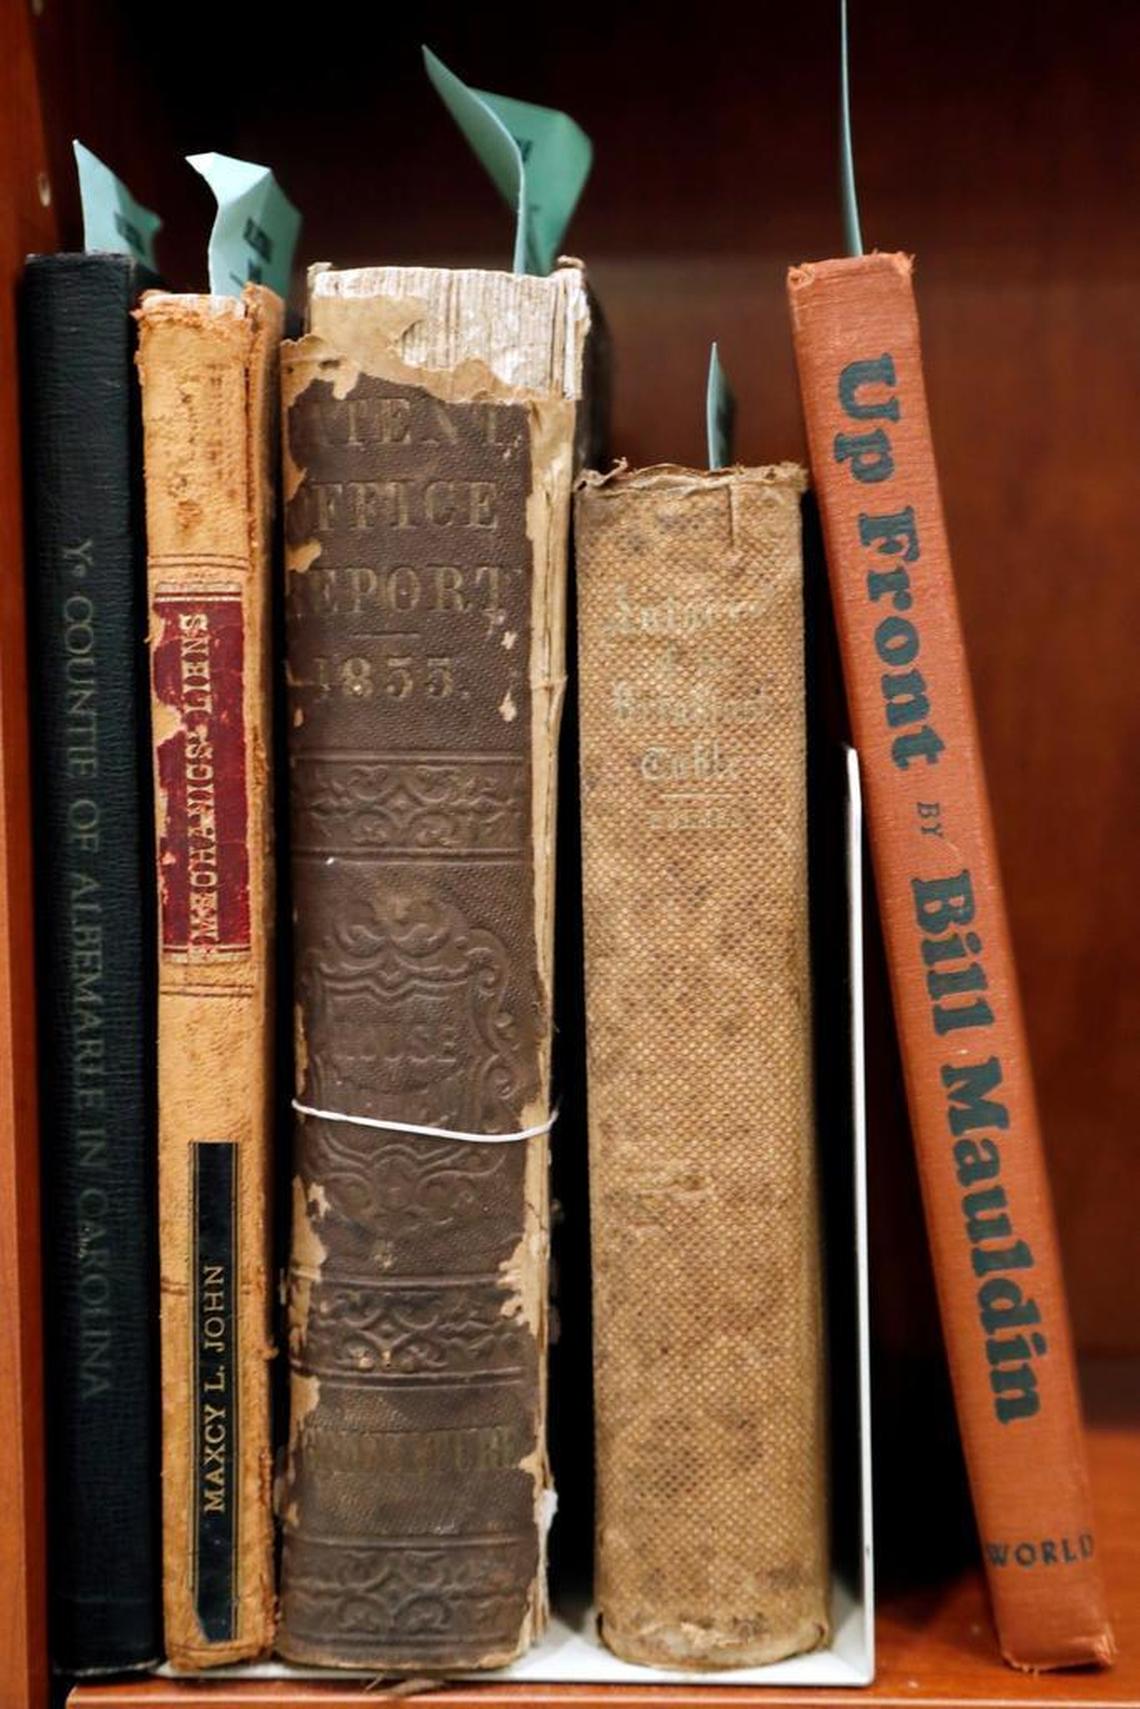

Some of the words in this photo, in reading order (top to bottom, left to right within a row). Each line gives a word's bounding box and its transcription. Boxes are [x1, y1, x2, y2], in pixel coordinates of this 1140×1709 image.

[834, 353, 901, 484] Up
[63, 595, 99, 780] COUNTIE
[179, 612, 212, 715] LIENS
[858, 507, 946, 770] Front
[68, 799, 102, 853] OF
[917, 801, 944, 839] BY
[70, 872, 106, 1109] ALBEMARLE
[911, 869, 996, 1037] Bill
[78, 1128, 108, 1168] IN
[77, 1187, 113, 1400] CAROLINA
[939, 1056, 1047, 1425] Mauldin
[202, 1264, 226, 1353] JOHN
[203, 1364, 226, 1393] L.
[203, 1403, 226, 1513] MAXCY
[986, 1533, 1094, 1568] WORLD
